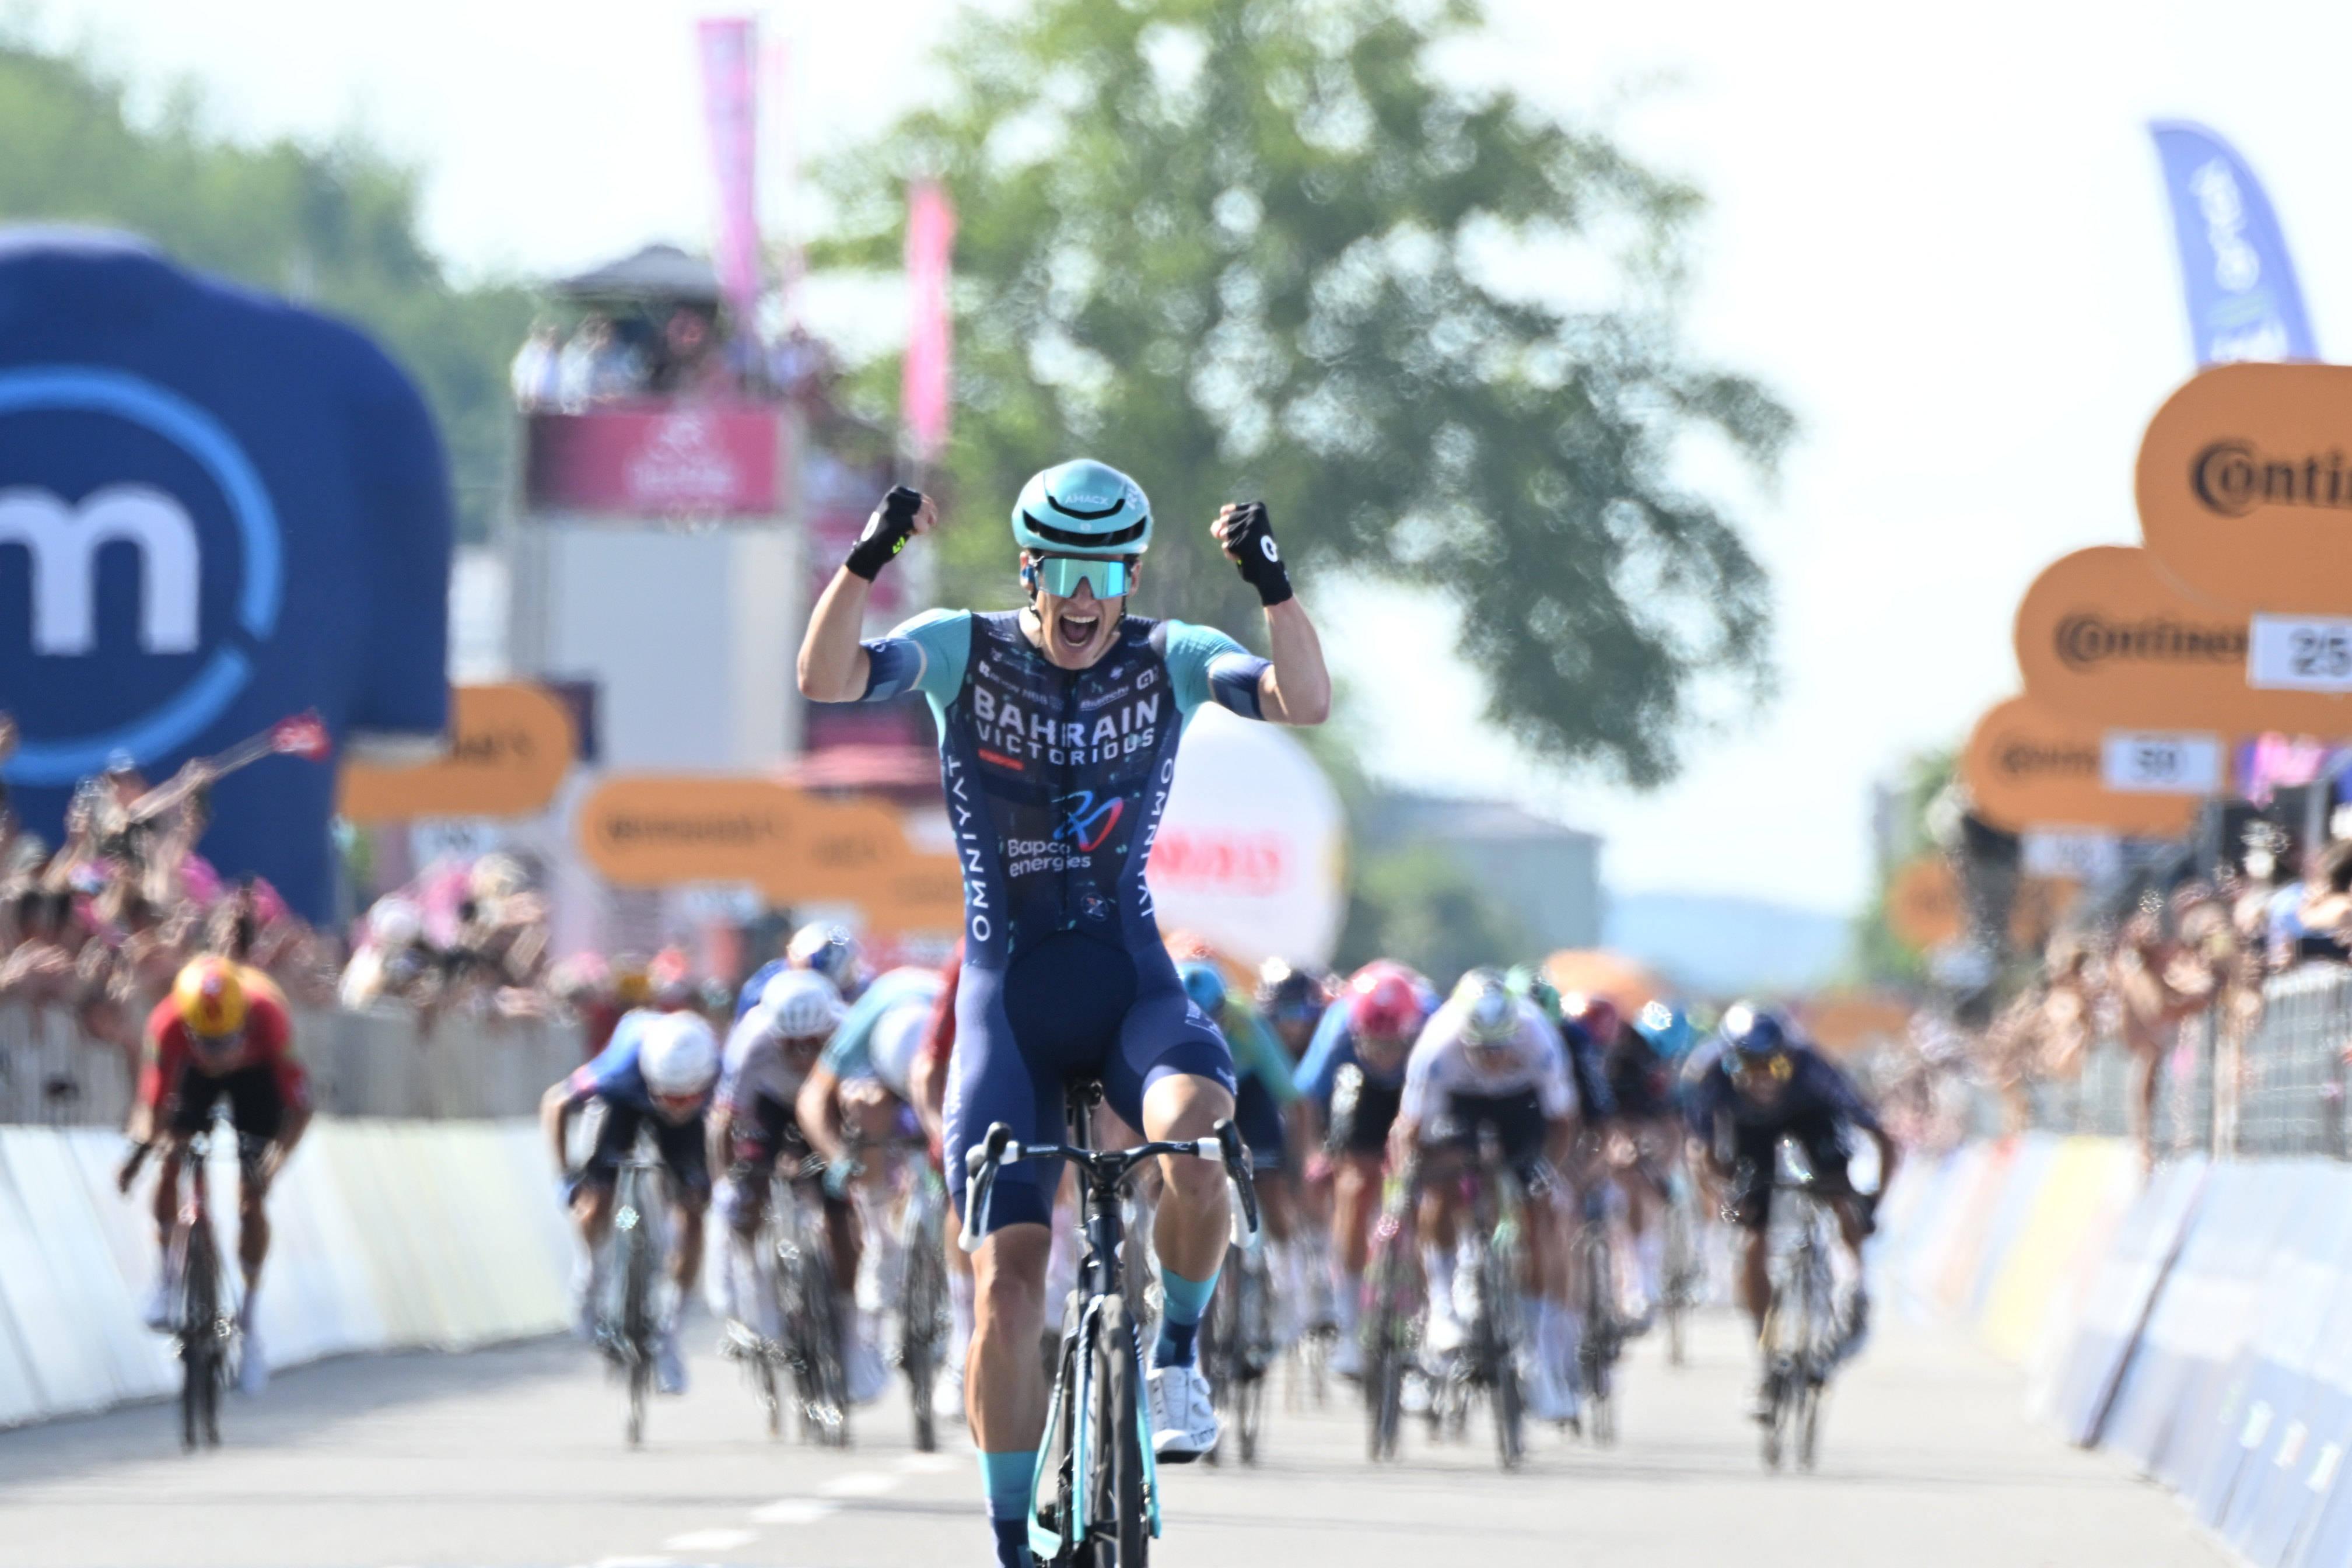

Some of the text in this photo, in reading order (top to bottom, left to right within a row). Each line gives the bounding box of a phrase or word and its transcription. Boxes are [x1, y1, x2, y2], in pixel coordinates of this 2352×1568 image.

[2192, 436, 2352, 519] Conti
[974, 684, 1160, 748] BAHRAIN
[976, 720, 1155, 766] VICTORIOUS
[947, 755, 991, 942] OMNIYAT
[1007, 838, 1071, 858] Bapco
[1009, 854, 1091, 877] energies
